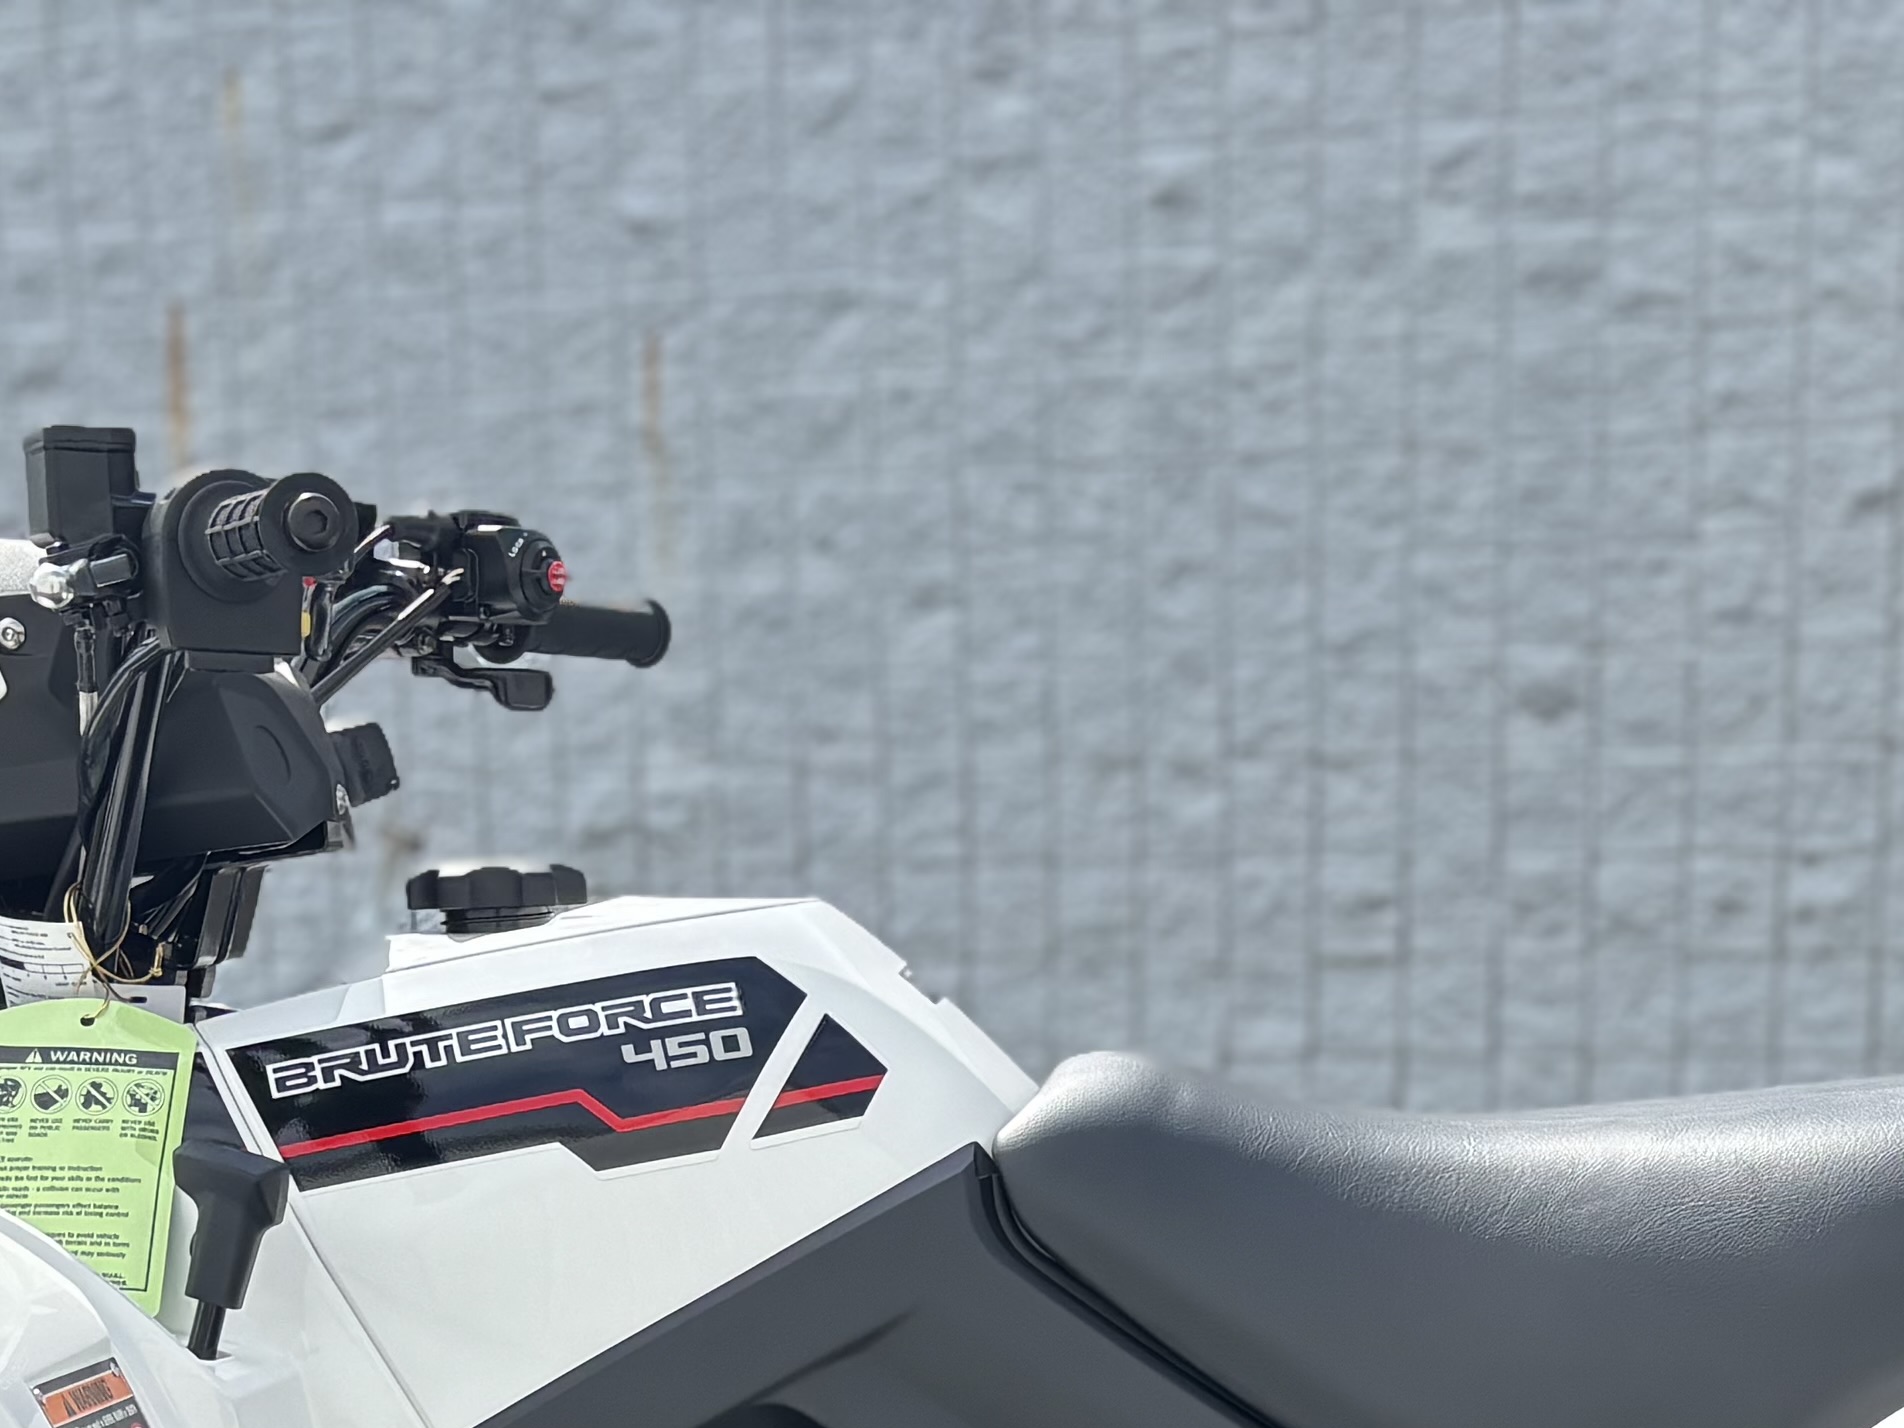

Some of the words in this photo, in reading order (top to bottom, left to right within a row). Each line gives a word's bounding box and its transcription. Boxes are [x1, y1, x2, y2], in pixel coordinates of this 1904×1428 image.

[49, 1050, 138, 1064] WARNING
[266, 1019, 503, 1099] BRUTE
[505, 982, 743, 1051] FORCE
[622, 1027, 753, 1072] 450
